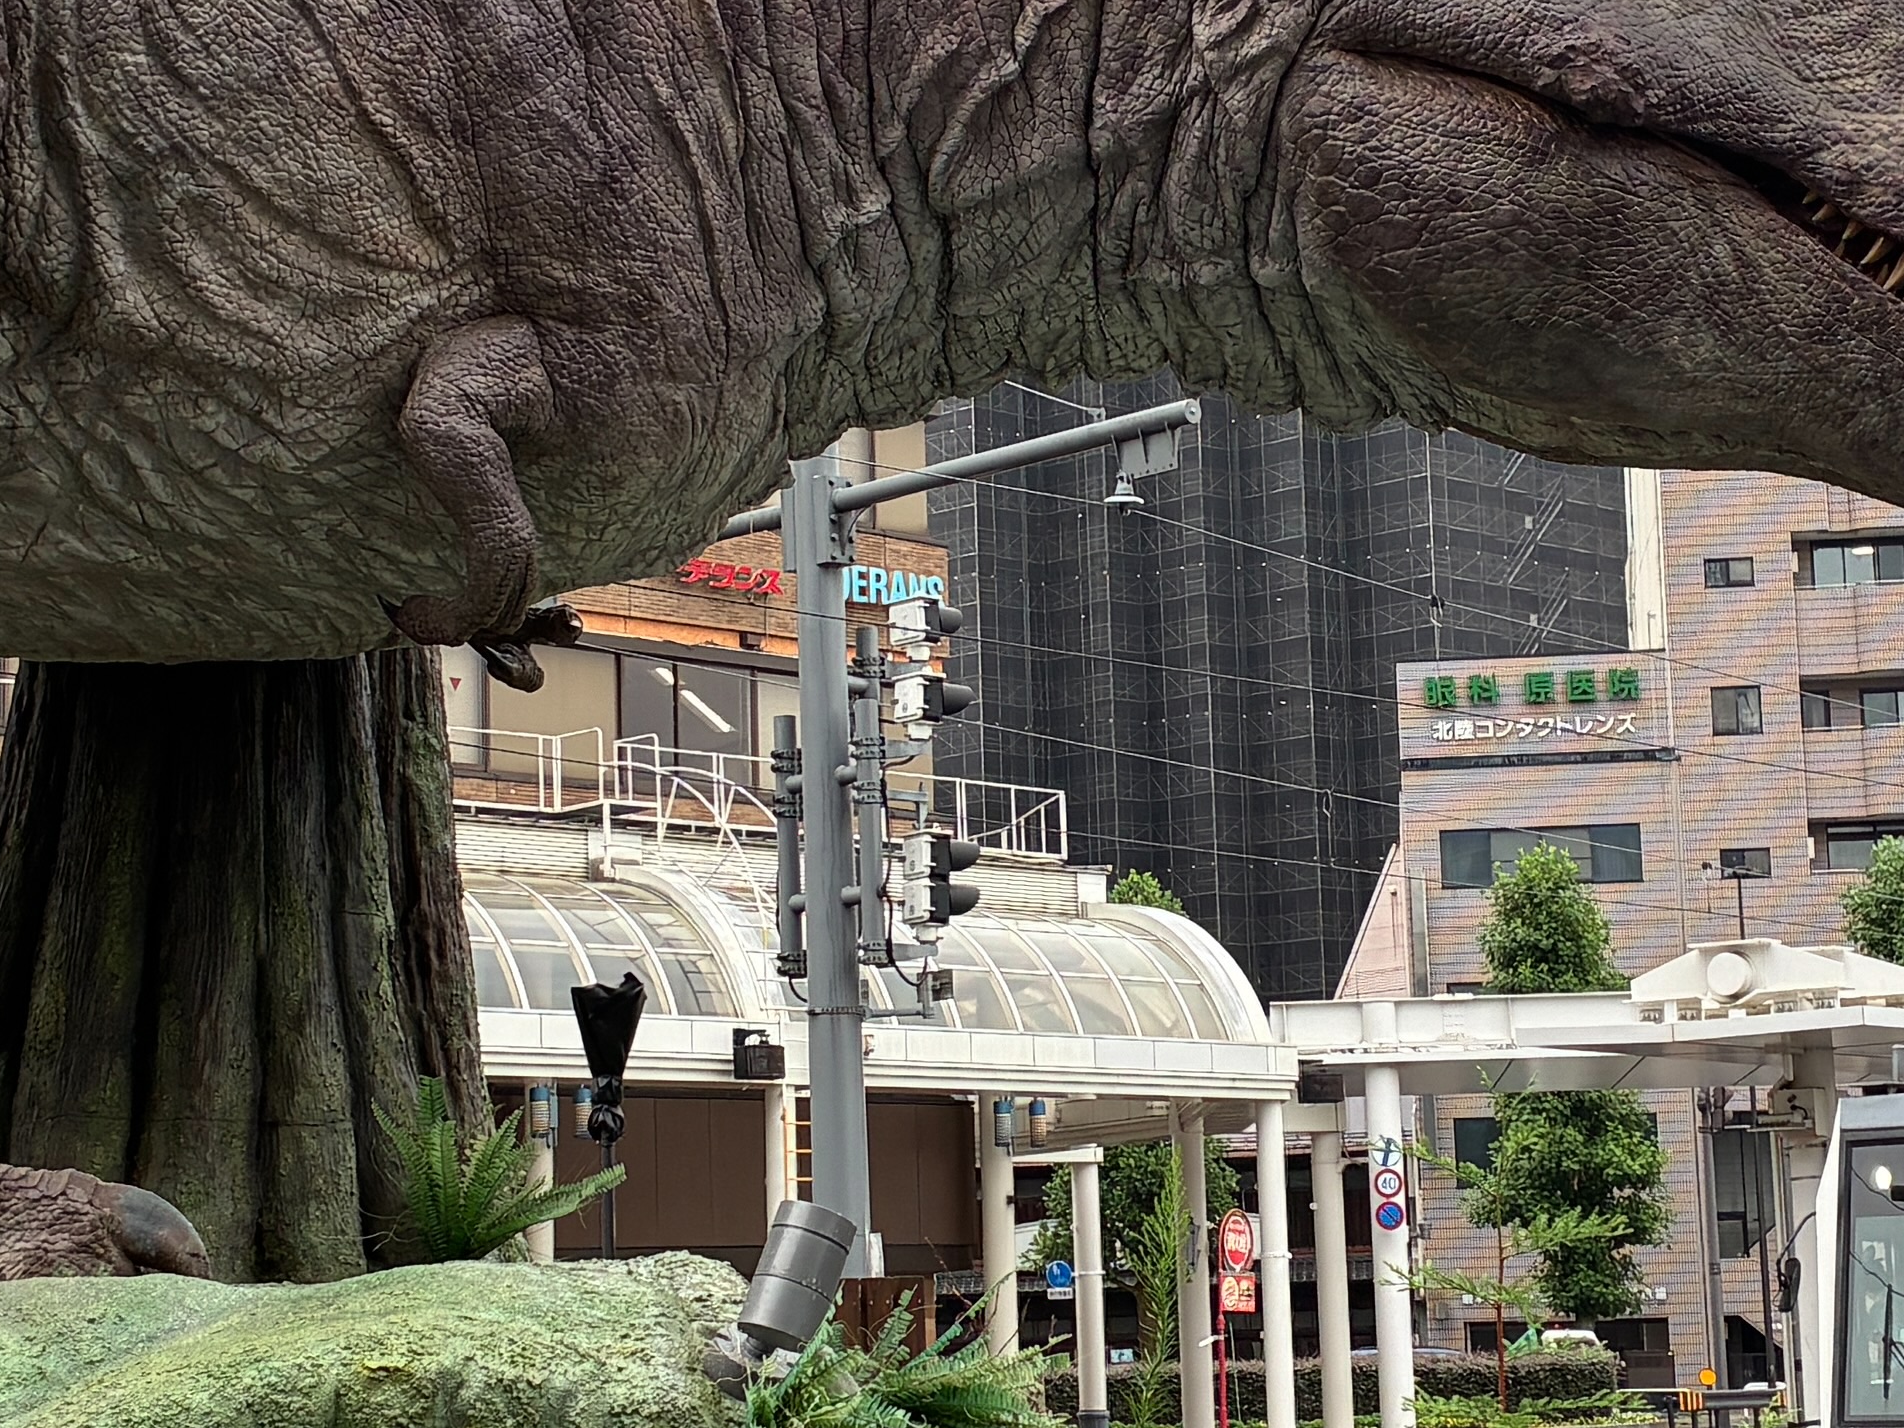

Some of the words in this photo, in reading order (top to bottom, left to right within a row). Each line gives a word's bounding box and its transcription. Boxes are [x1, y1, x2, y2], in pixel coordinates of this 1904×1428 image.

[843, 564, 944, 609] ERANS
[1424, 673, 1501, 709] 眼科
[1524, 666, 1641, 705] 原医院
[1431, 713, 1637, 741] 北陸コンタクトレンズ
[1381, 1176, 1396, 1190] 40
